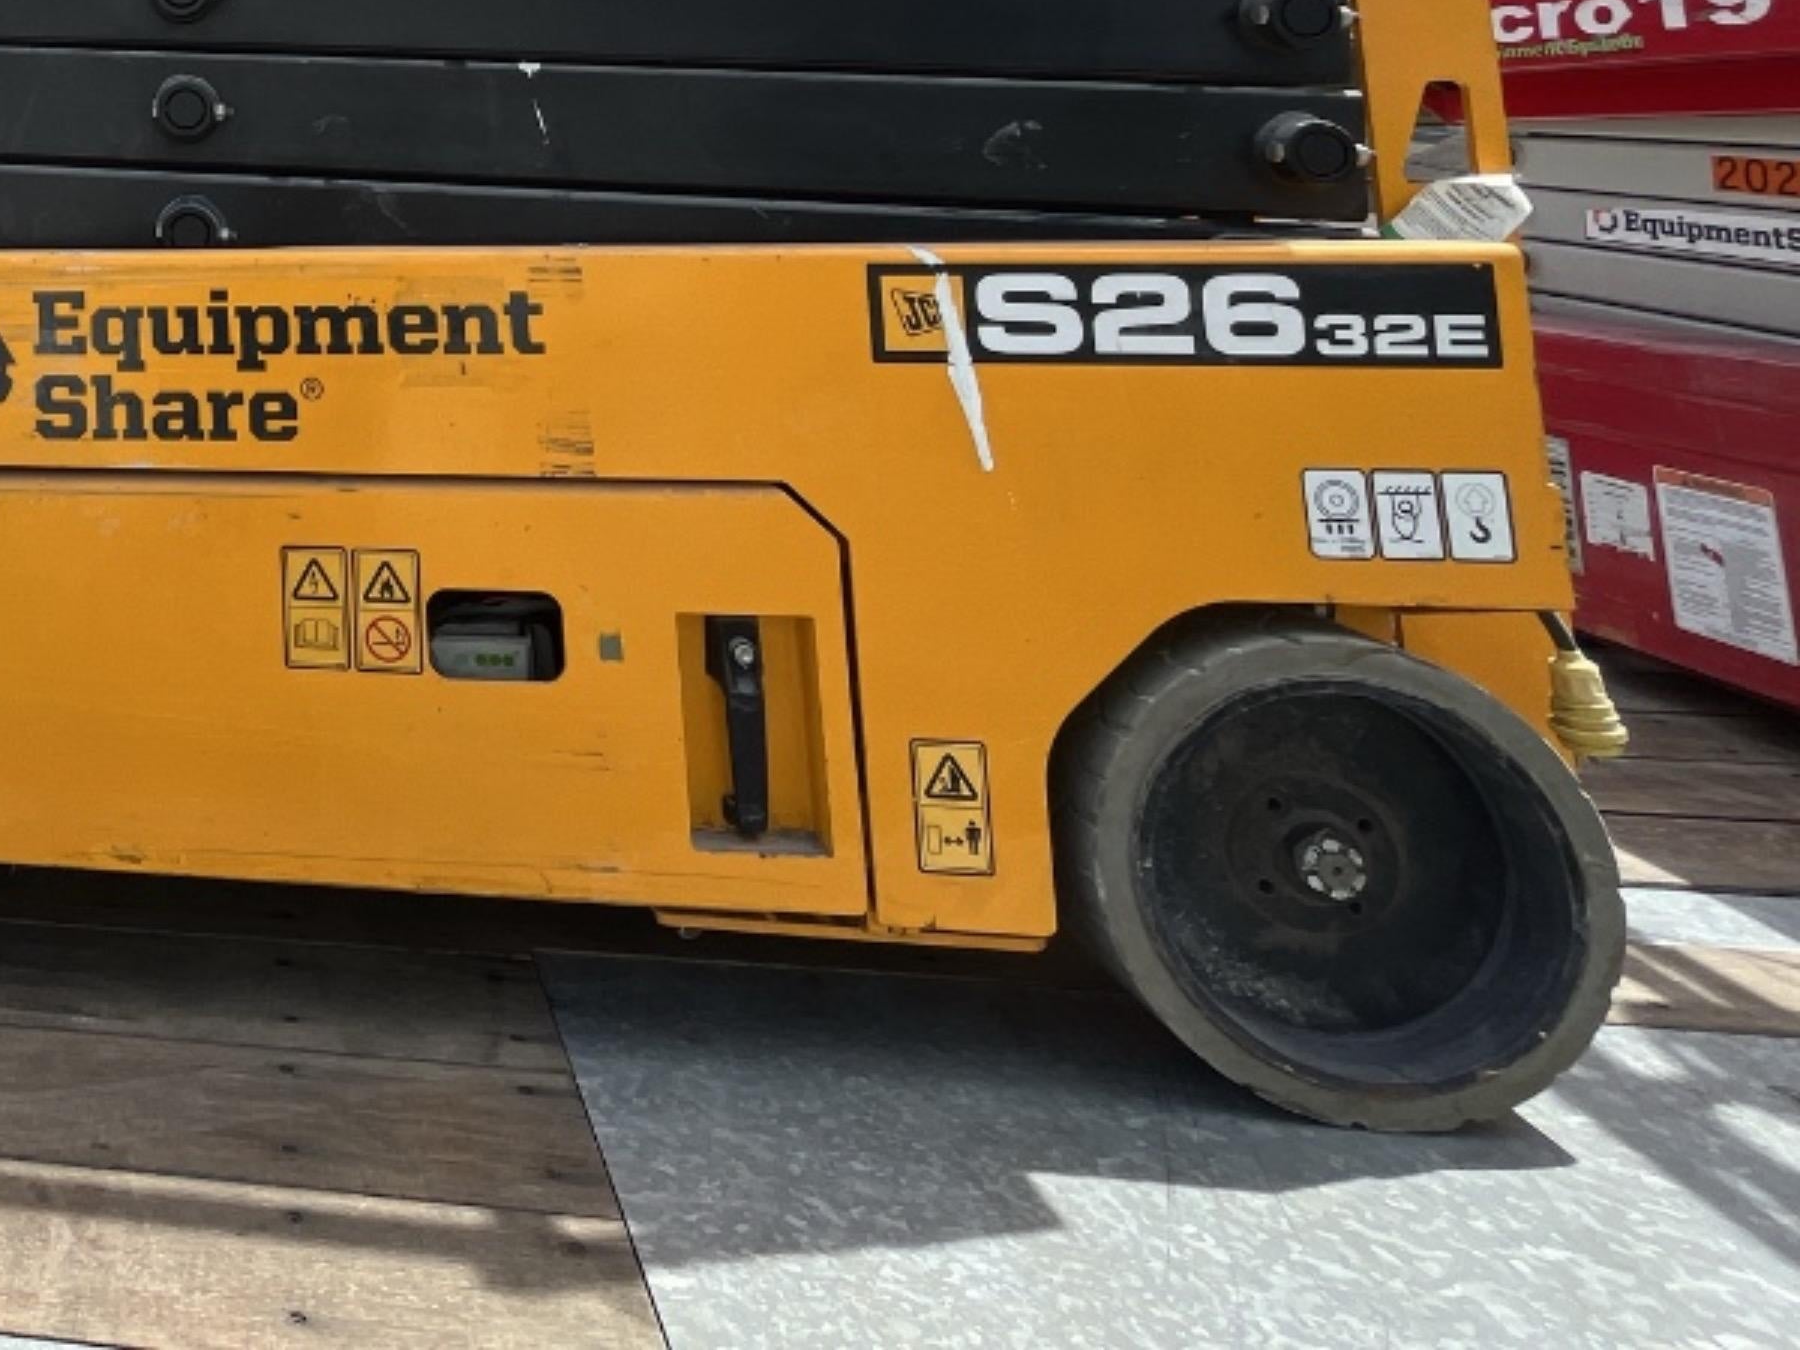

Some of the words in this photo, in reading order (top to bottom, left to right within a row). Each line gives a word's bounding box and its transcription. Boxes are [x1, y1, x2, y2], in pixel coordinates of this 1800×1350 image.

[31, 288, 547, 372] Equipment
[975, 272, 1307, 356] S26
[1313, 313, 1491, 358] 32E
